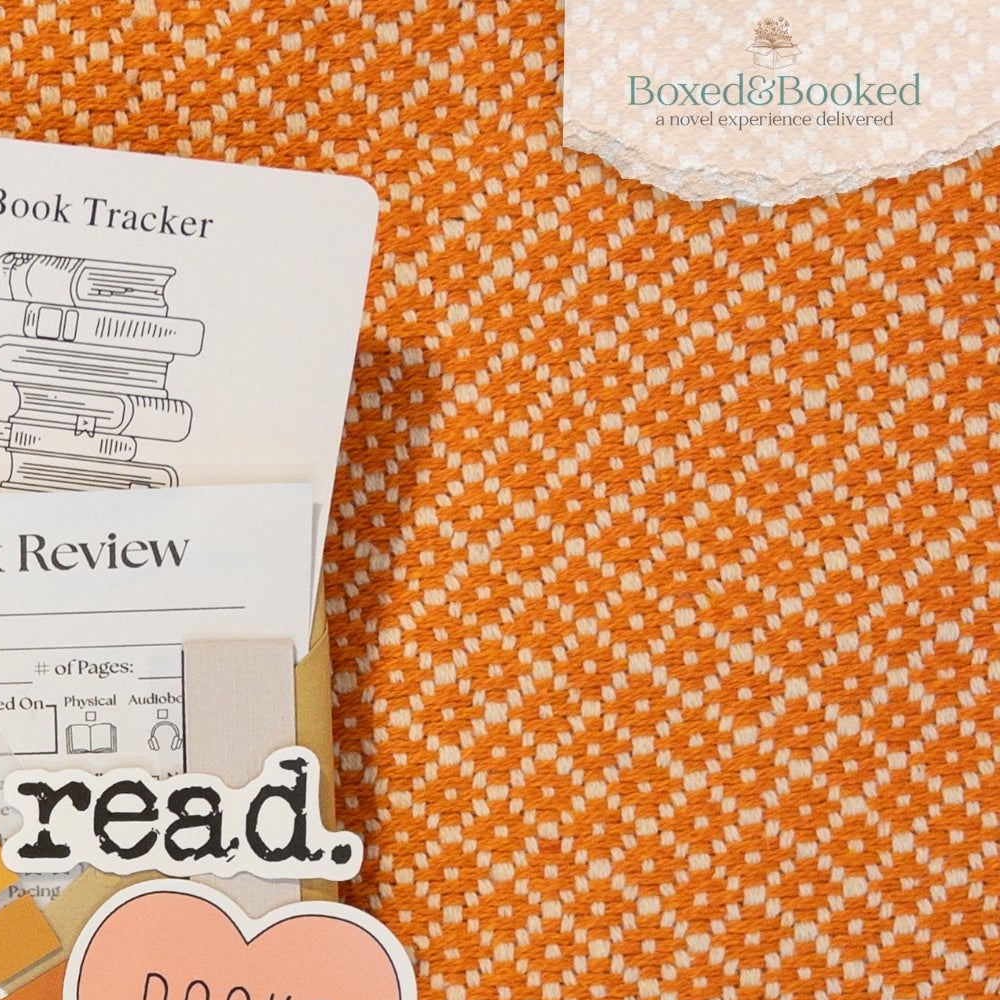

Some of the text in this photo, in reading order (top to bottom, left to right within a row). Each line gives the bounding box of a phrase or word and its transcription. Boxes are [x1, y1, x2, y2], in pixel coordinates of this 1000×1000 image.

[83, 197, 215, 239] Tracker
[17, 532, 191, 573] Review
[54, 658, 77, 676] of
[78, 660, 134, 679] Pages:
[19, 697, 44, 710] On
[63, 694, 117, 709] Physical
[17, 757, 353, 863] read.
[8, 885, 61, 900] Pacing
